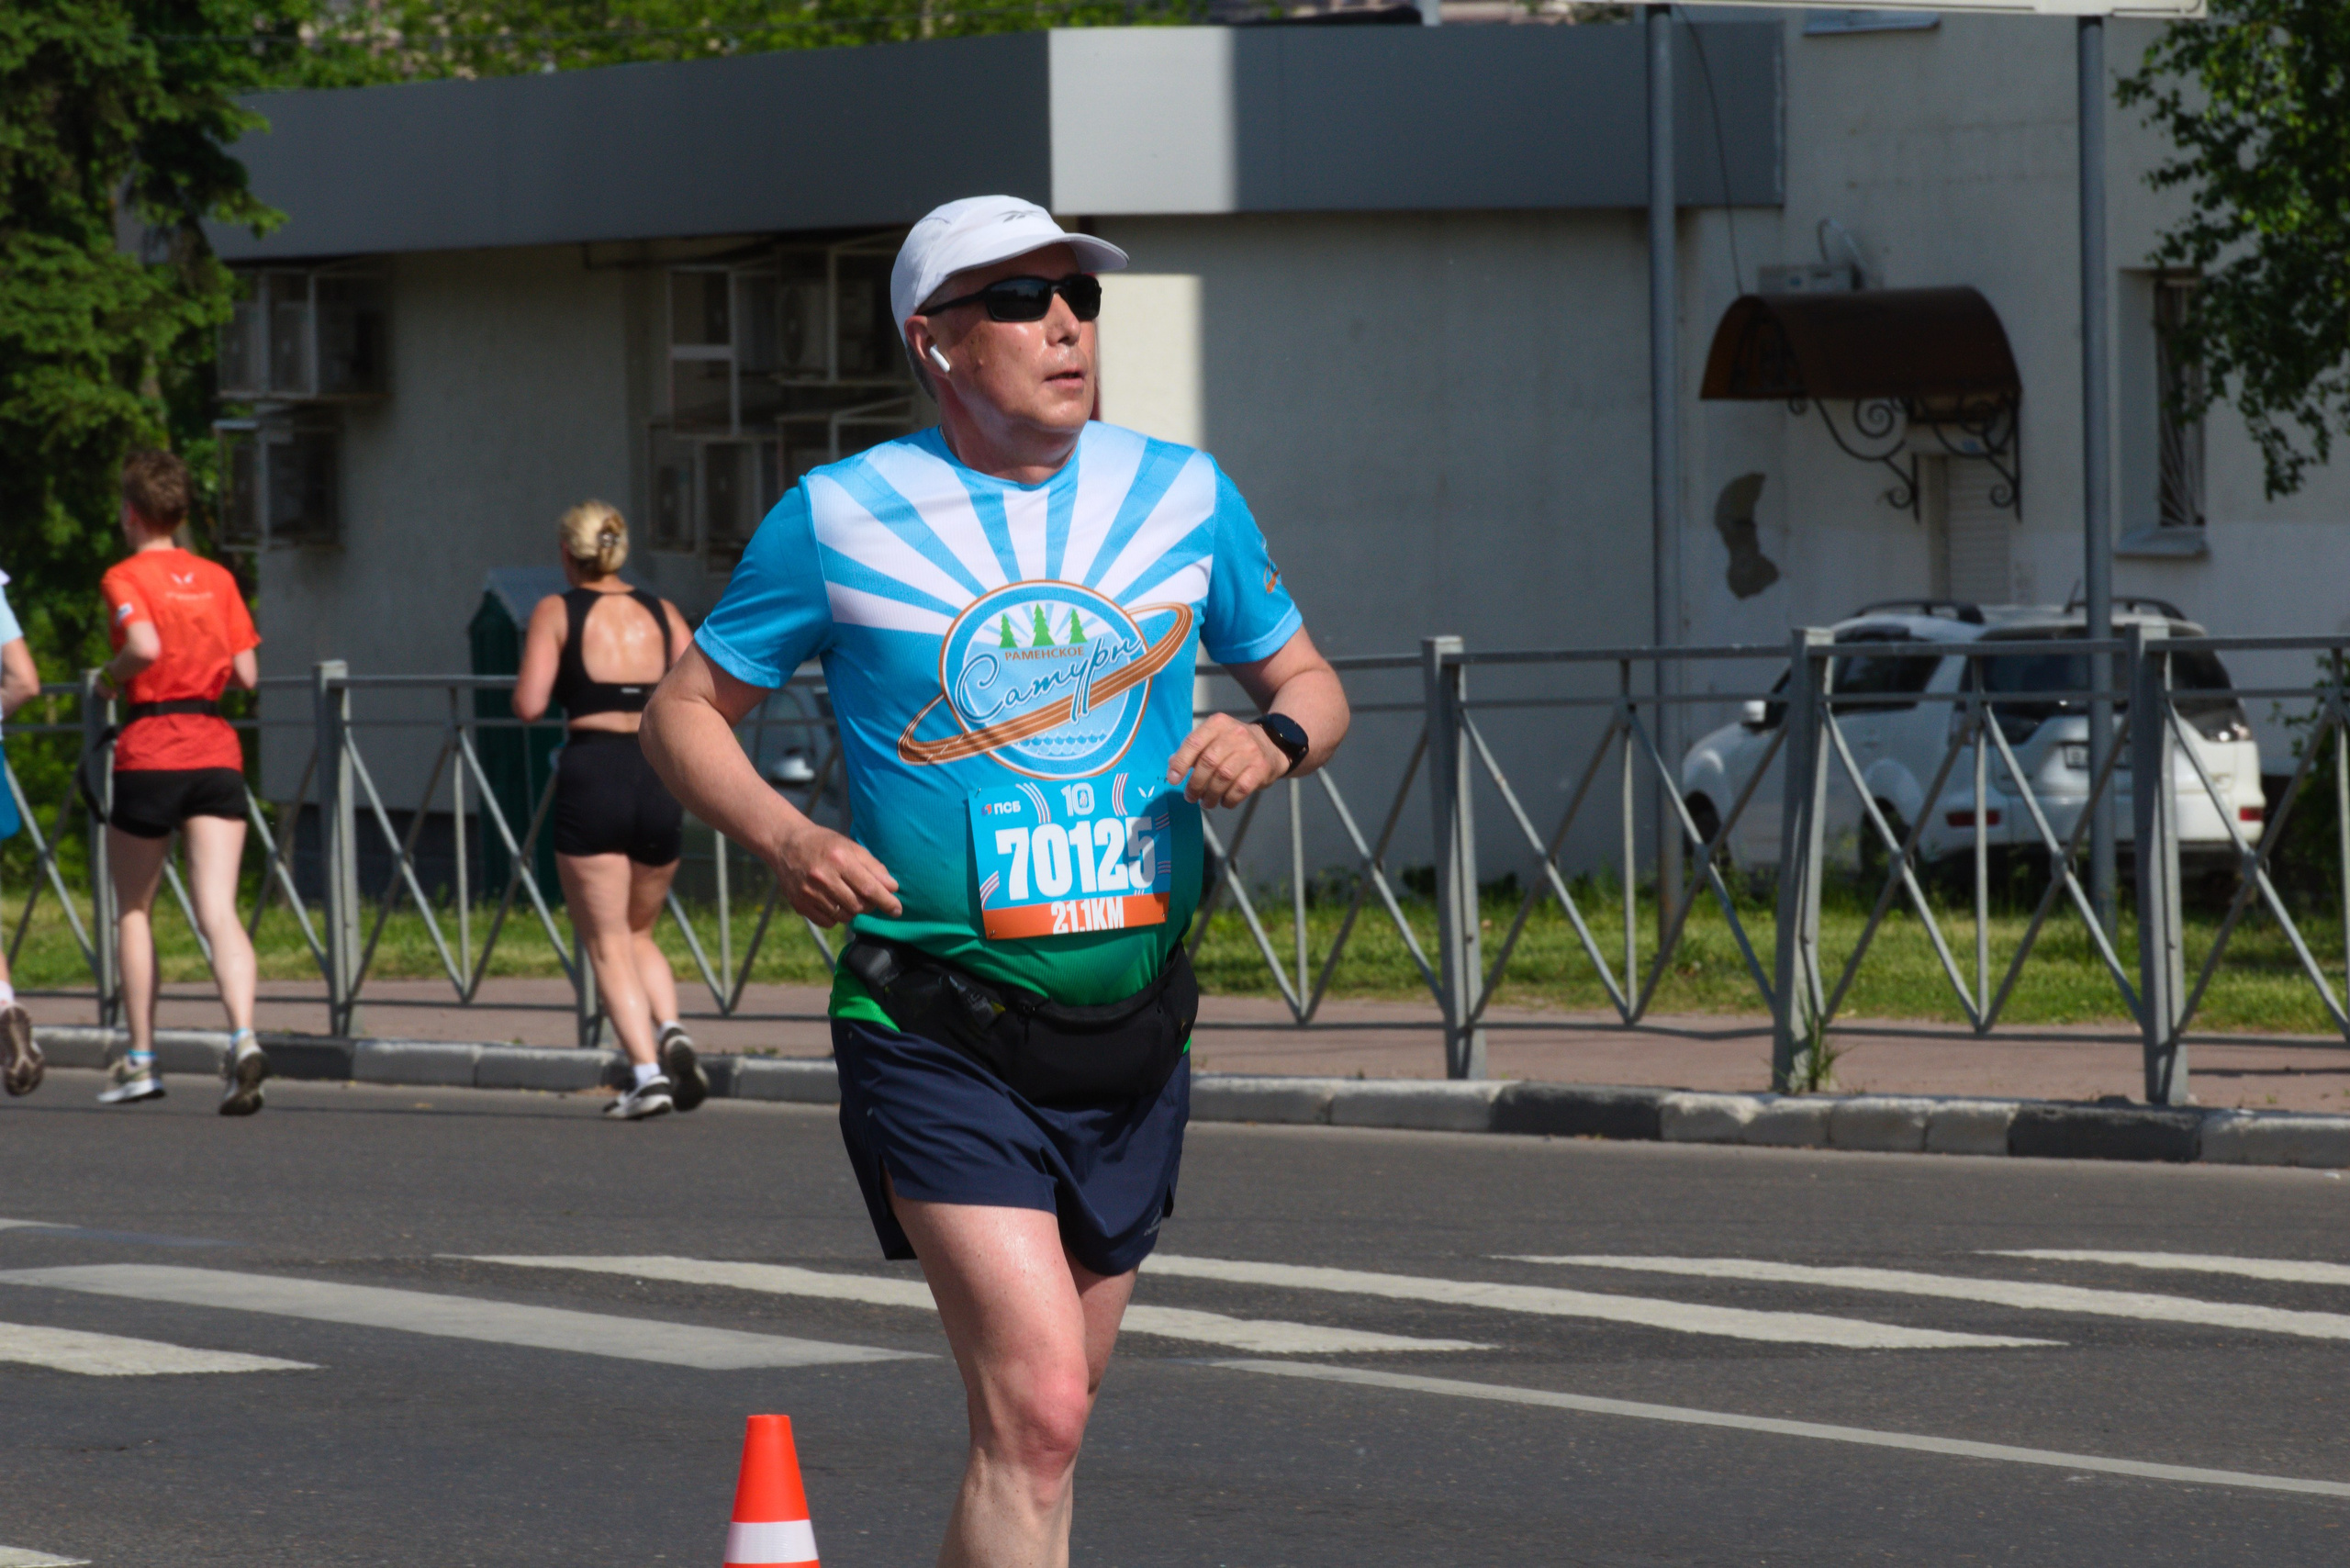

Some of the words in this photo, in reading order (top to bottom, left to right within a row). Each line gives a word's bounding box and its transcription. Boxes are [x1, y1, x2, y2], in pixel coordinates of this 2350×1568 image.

[1004, 646, 1084, 661] РАМЕНСКОЕ
[955, 637, 1144, 725] Сатурн
[993, 800, 1022, 815] ПСБ
[1060, 782, 1095, 817] 10
[995, 817, 1156, 901] 70125
[1051, 896, 1125, 935] 21.1KM
